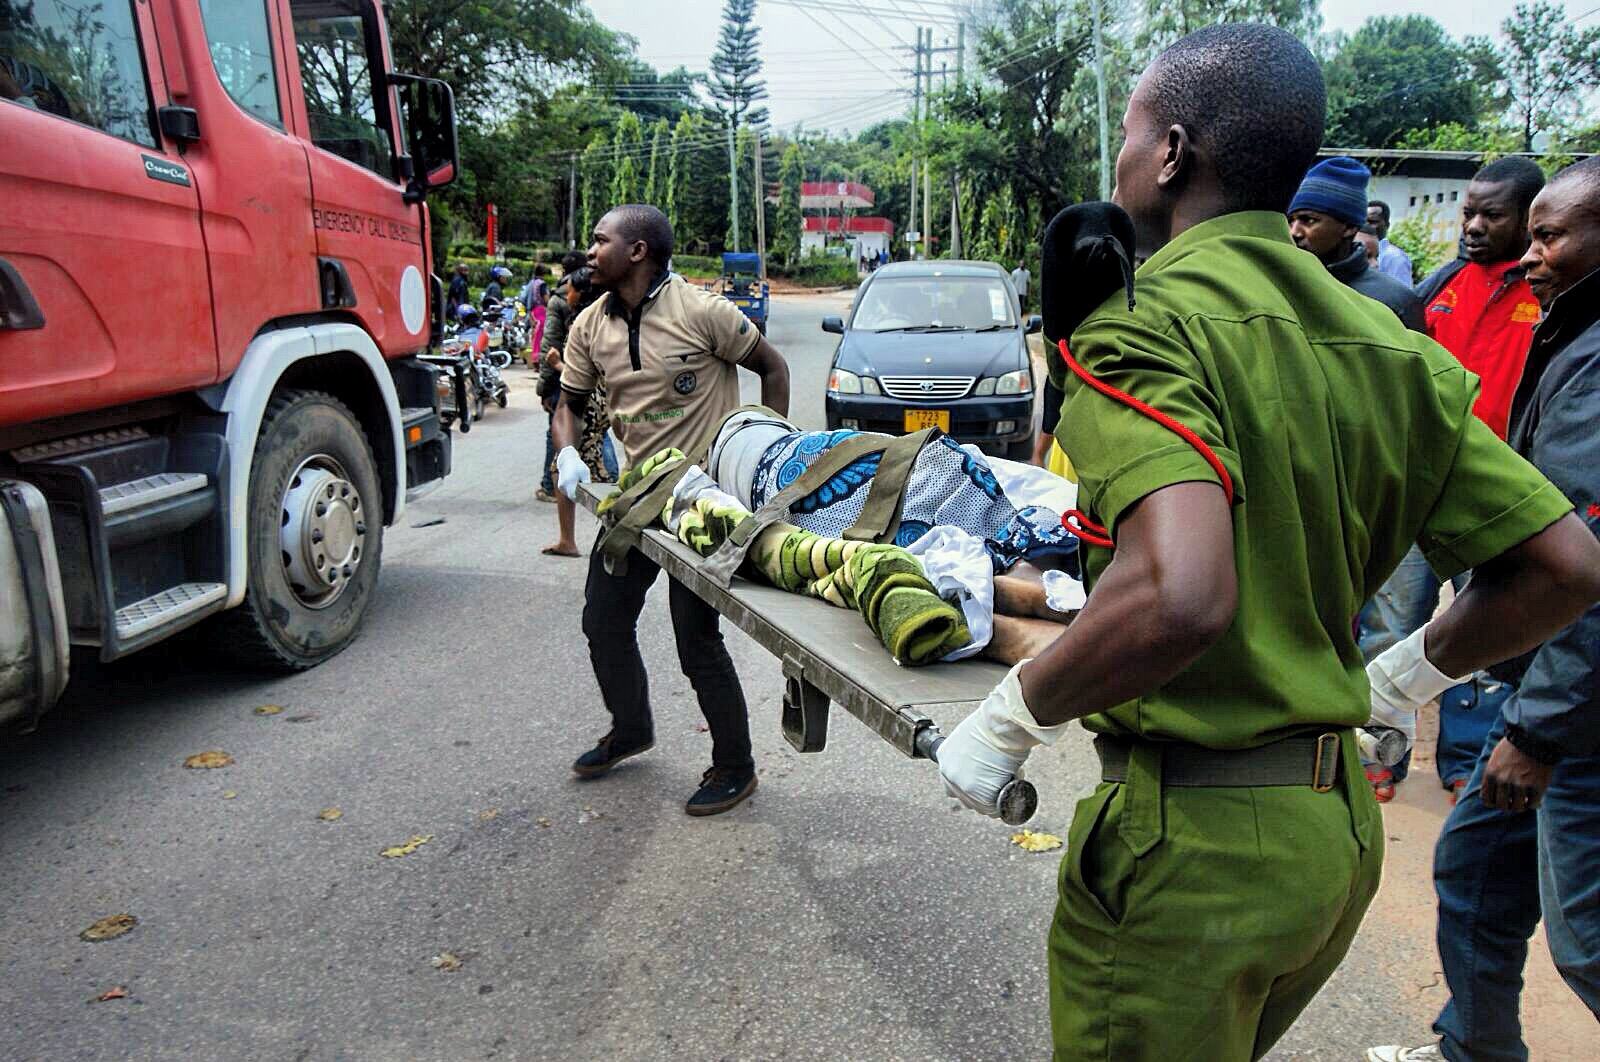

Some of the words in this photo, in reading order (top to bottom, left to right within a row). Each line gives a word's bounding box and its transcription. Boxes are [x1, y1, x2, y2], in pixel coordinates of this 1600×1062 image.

[314, 208, 365, 235] EMERGENCY
[368, 217, 387, 239] CALL
[644, 407, 684, 422] Pharmacy
